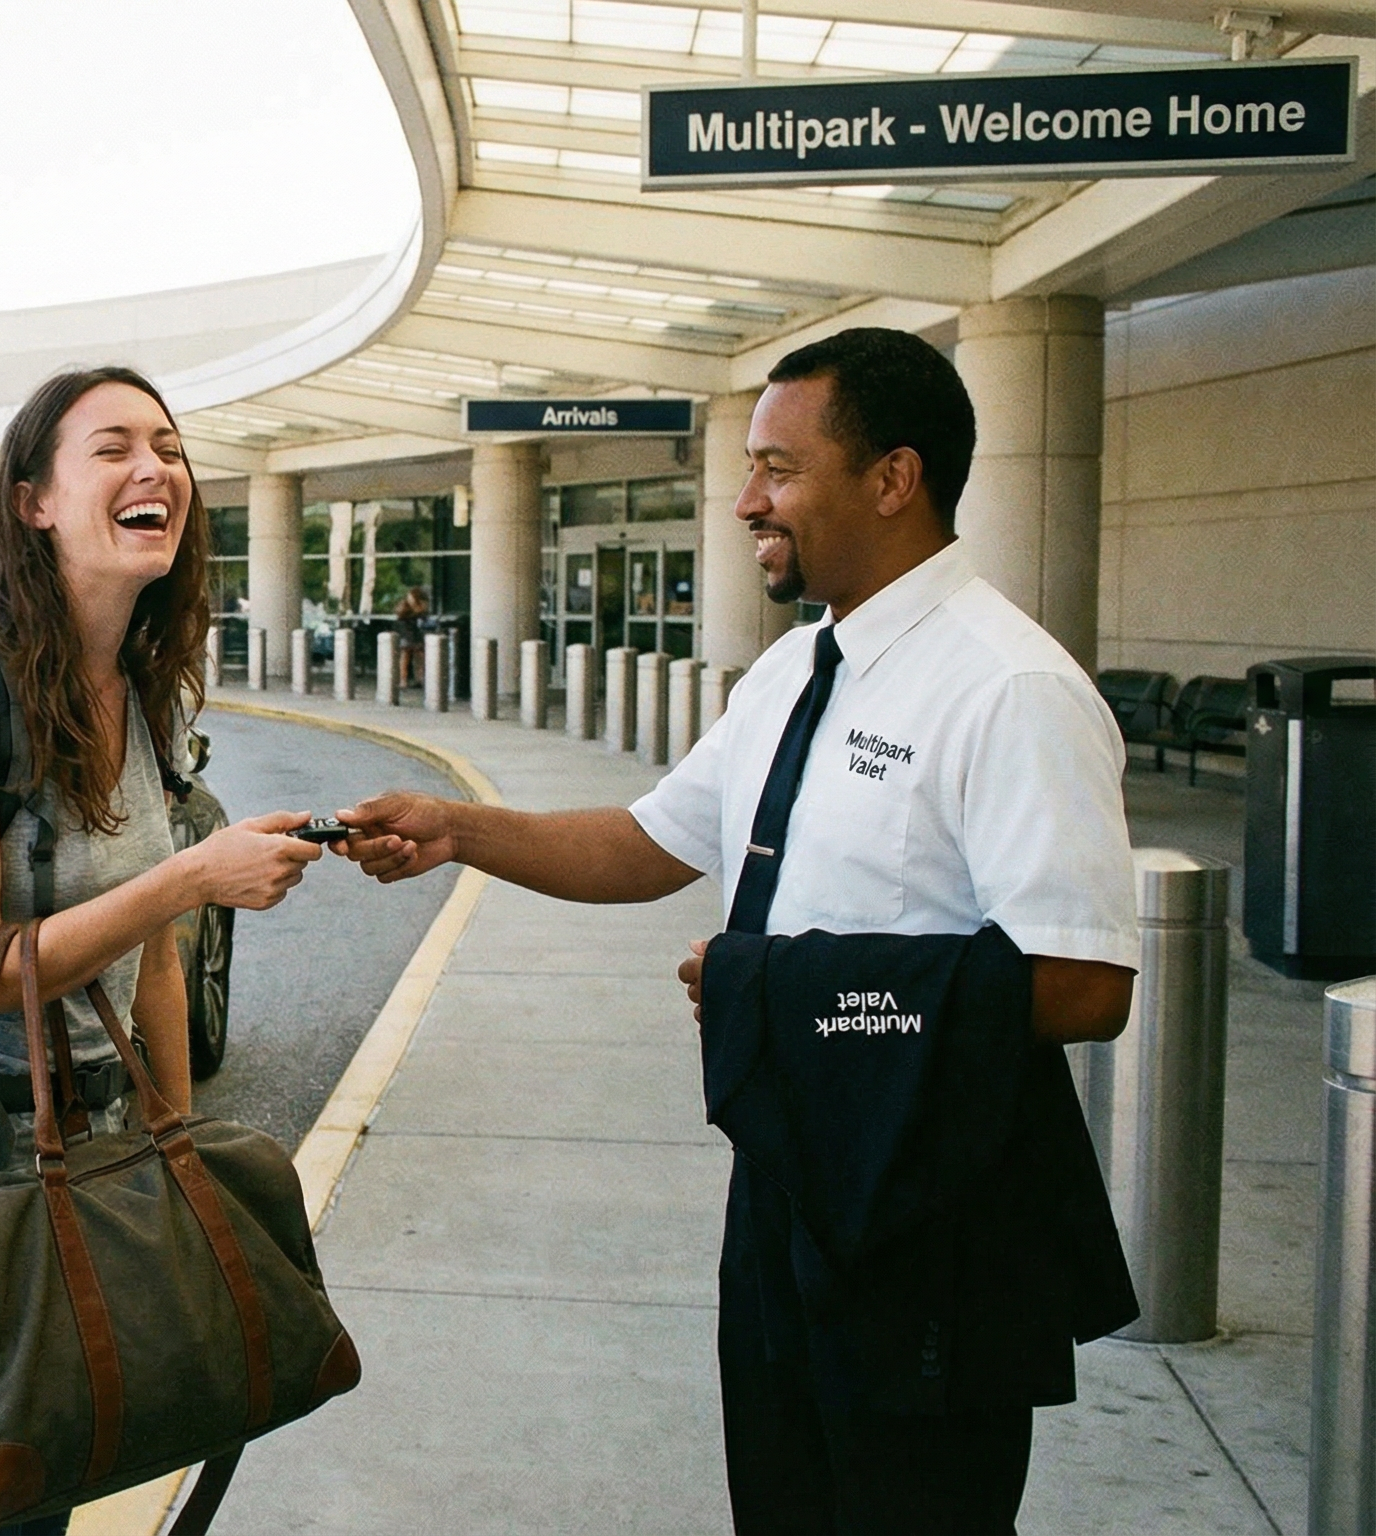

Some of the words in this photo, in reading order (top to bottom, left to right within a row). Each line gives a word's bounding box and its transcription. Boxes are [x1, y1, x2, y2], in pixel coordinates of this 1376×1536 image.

[688, 107, 896, 160] Multipark
[909, 124, 926, 135] -
[939, 102, 1152, 144] Welcome
[1169, 94, 1306, 136] Home
[541, 406, 619, 426] Arrivals
[845, 728, 916, 764] Multipark
[848, 752, 887, 781] Valet
[836, 991, 899, 1012] Valet
[814, 1012, 922, 1038] Multipark
